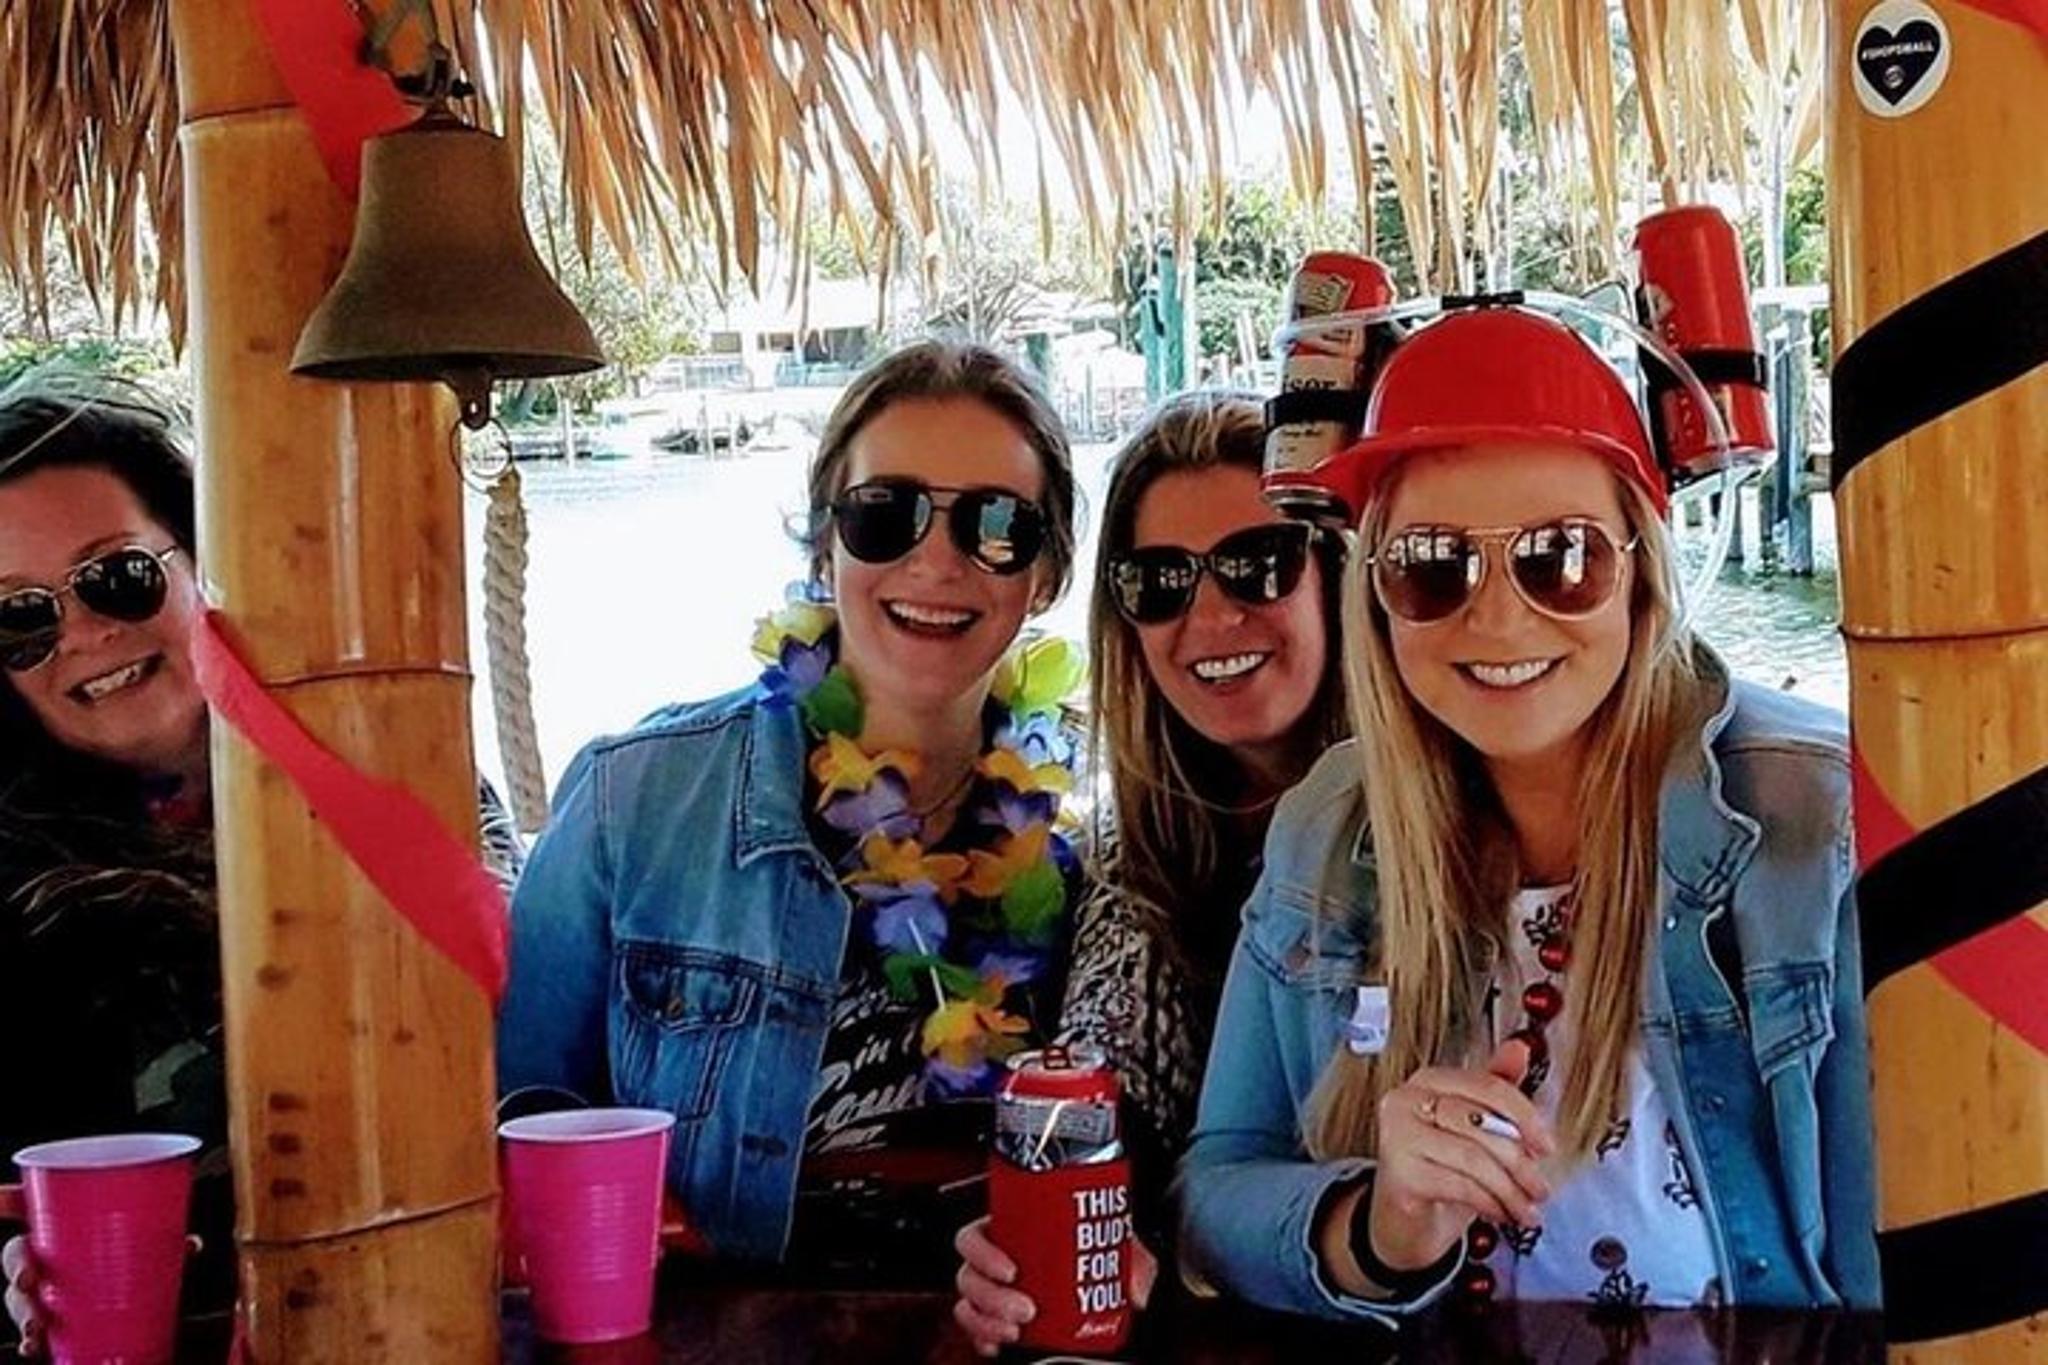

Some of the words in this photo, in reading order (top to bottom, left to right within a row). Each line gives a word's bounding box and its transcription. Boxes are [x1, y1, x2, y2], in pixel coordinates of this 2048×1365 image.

[1072, 1185, 1128, 1219] THIS
[1077, 1250, 1119, 1282] FOR
[1077, 1281, 1127, 1314] YOU.
